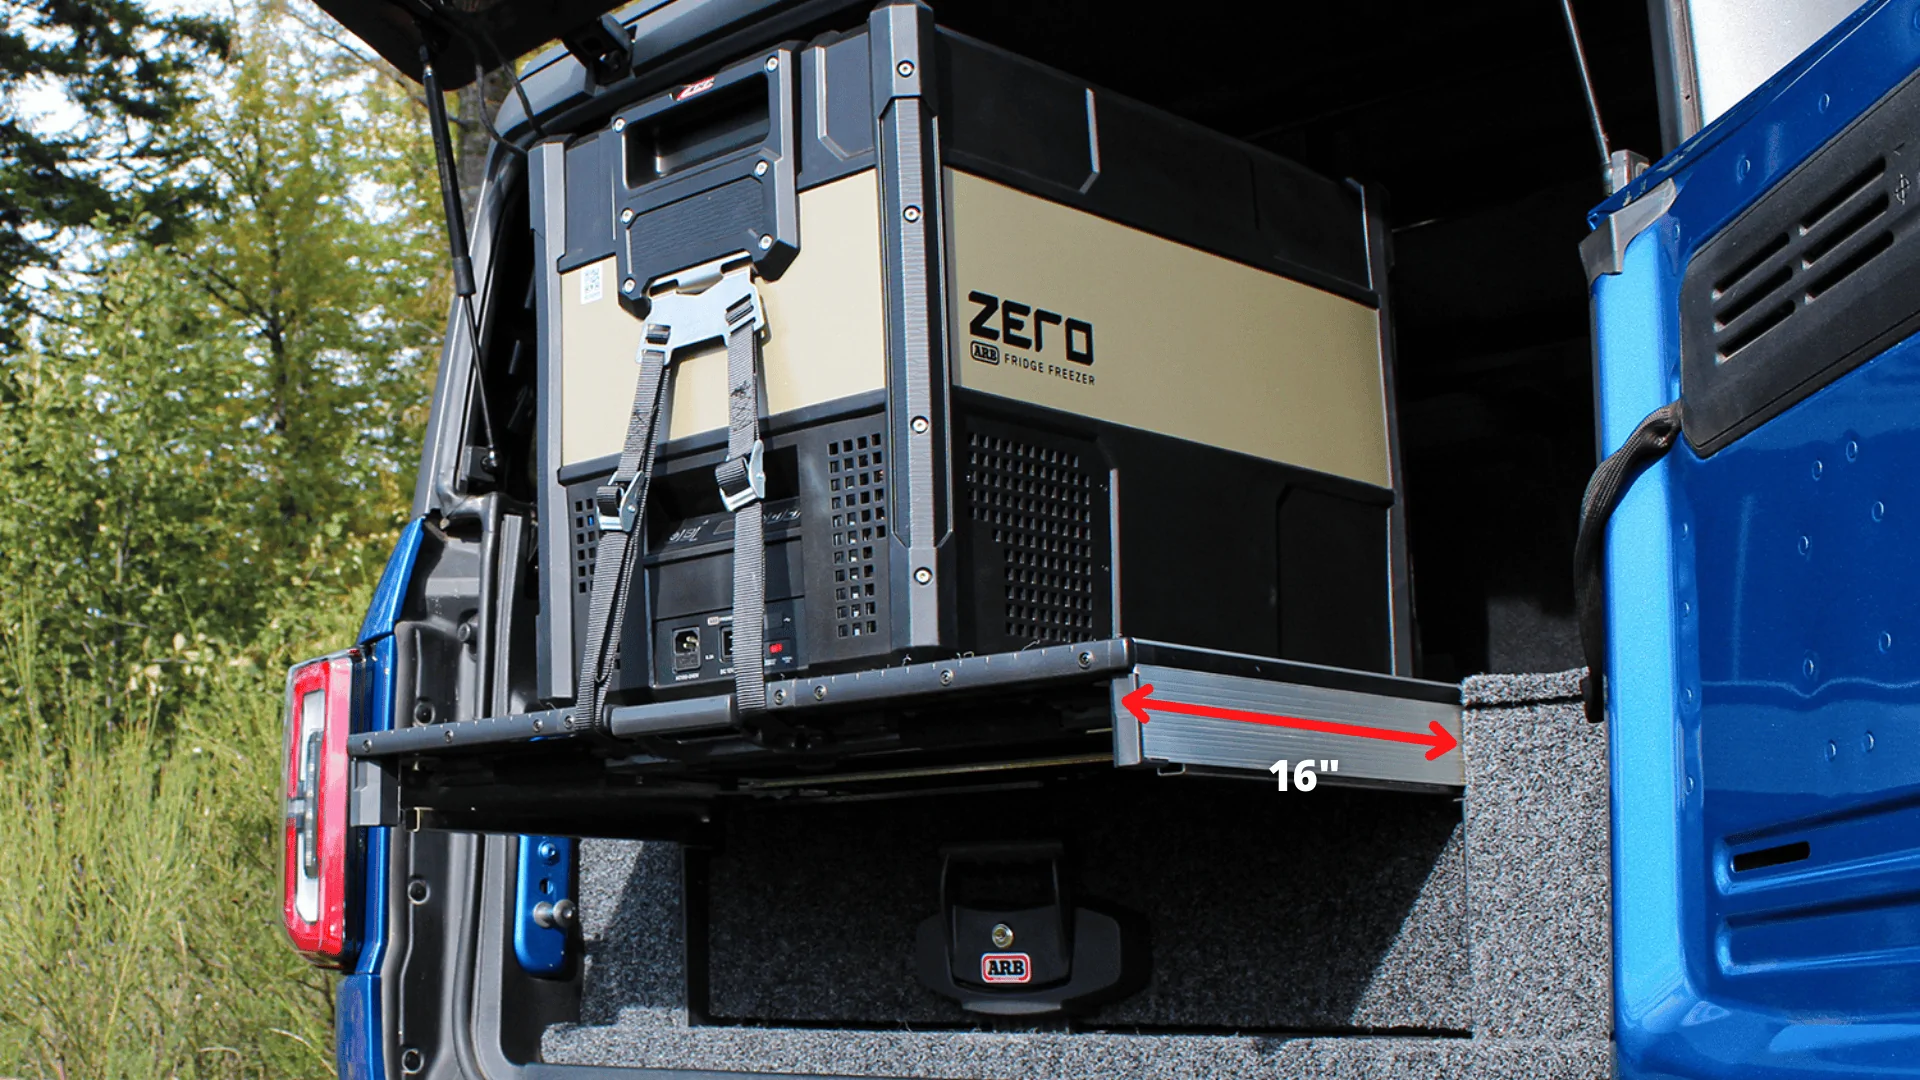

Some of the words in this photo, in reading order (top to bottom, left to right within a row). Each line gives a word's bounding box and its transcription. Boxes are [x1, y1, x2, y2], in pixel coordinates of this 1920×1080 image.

[968, 290, 1094, 366] ZERO
[973, 344, 998, 361] ARB
[1004, 353, 1044, 373] FRIDGE
[1048, 364, 1095, 386] FREEZER
[987, 960, 1025, 976] ARB
